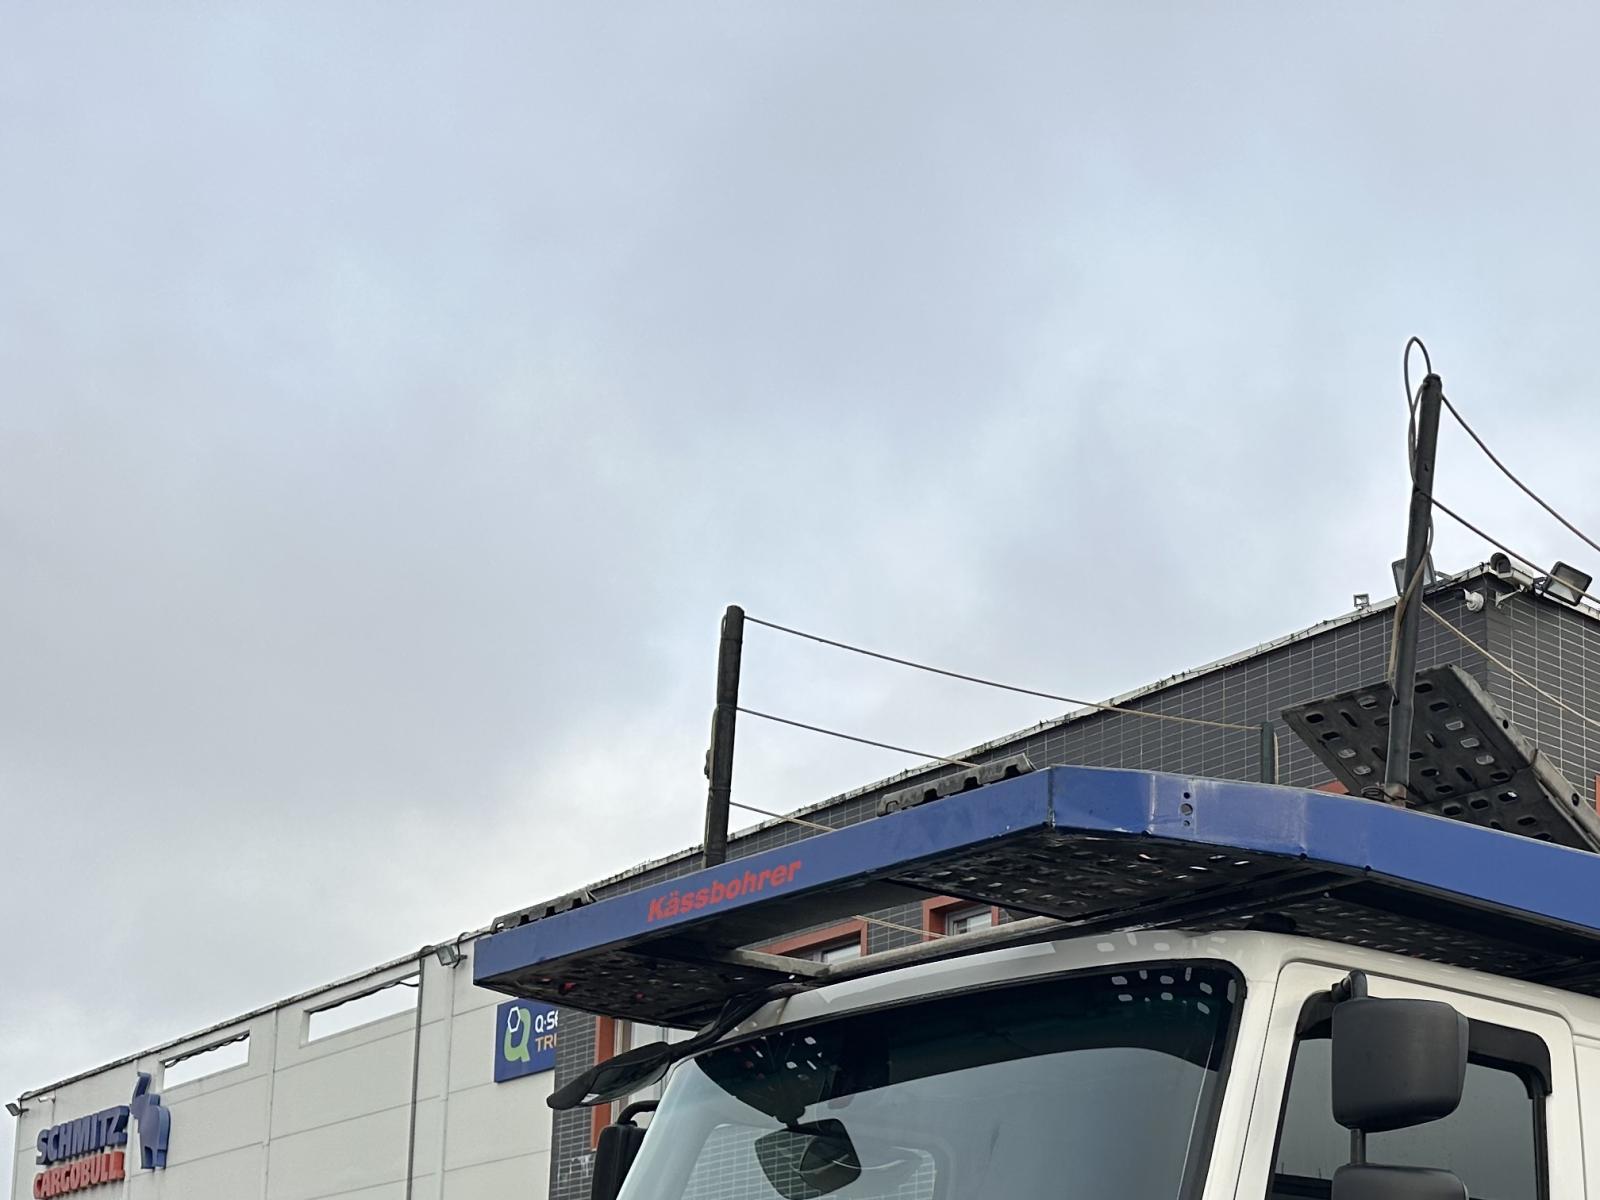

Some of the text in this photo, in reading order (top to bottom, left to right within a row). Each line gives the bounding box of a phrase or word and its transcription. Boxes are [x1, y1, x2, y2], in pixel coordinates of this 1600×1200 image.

[646, 859, 802, 923] Kässbohrer
[36, 1104, 130, 1166] SCHMITZ
[33, 1150, 125, 1200] CARGOBULL
